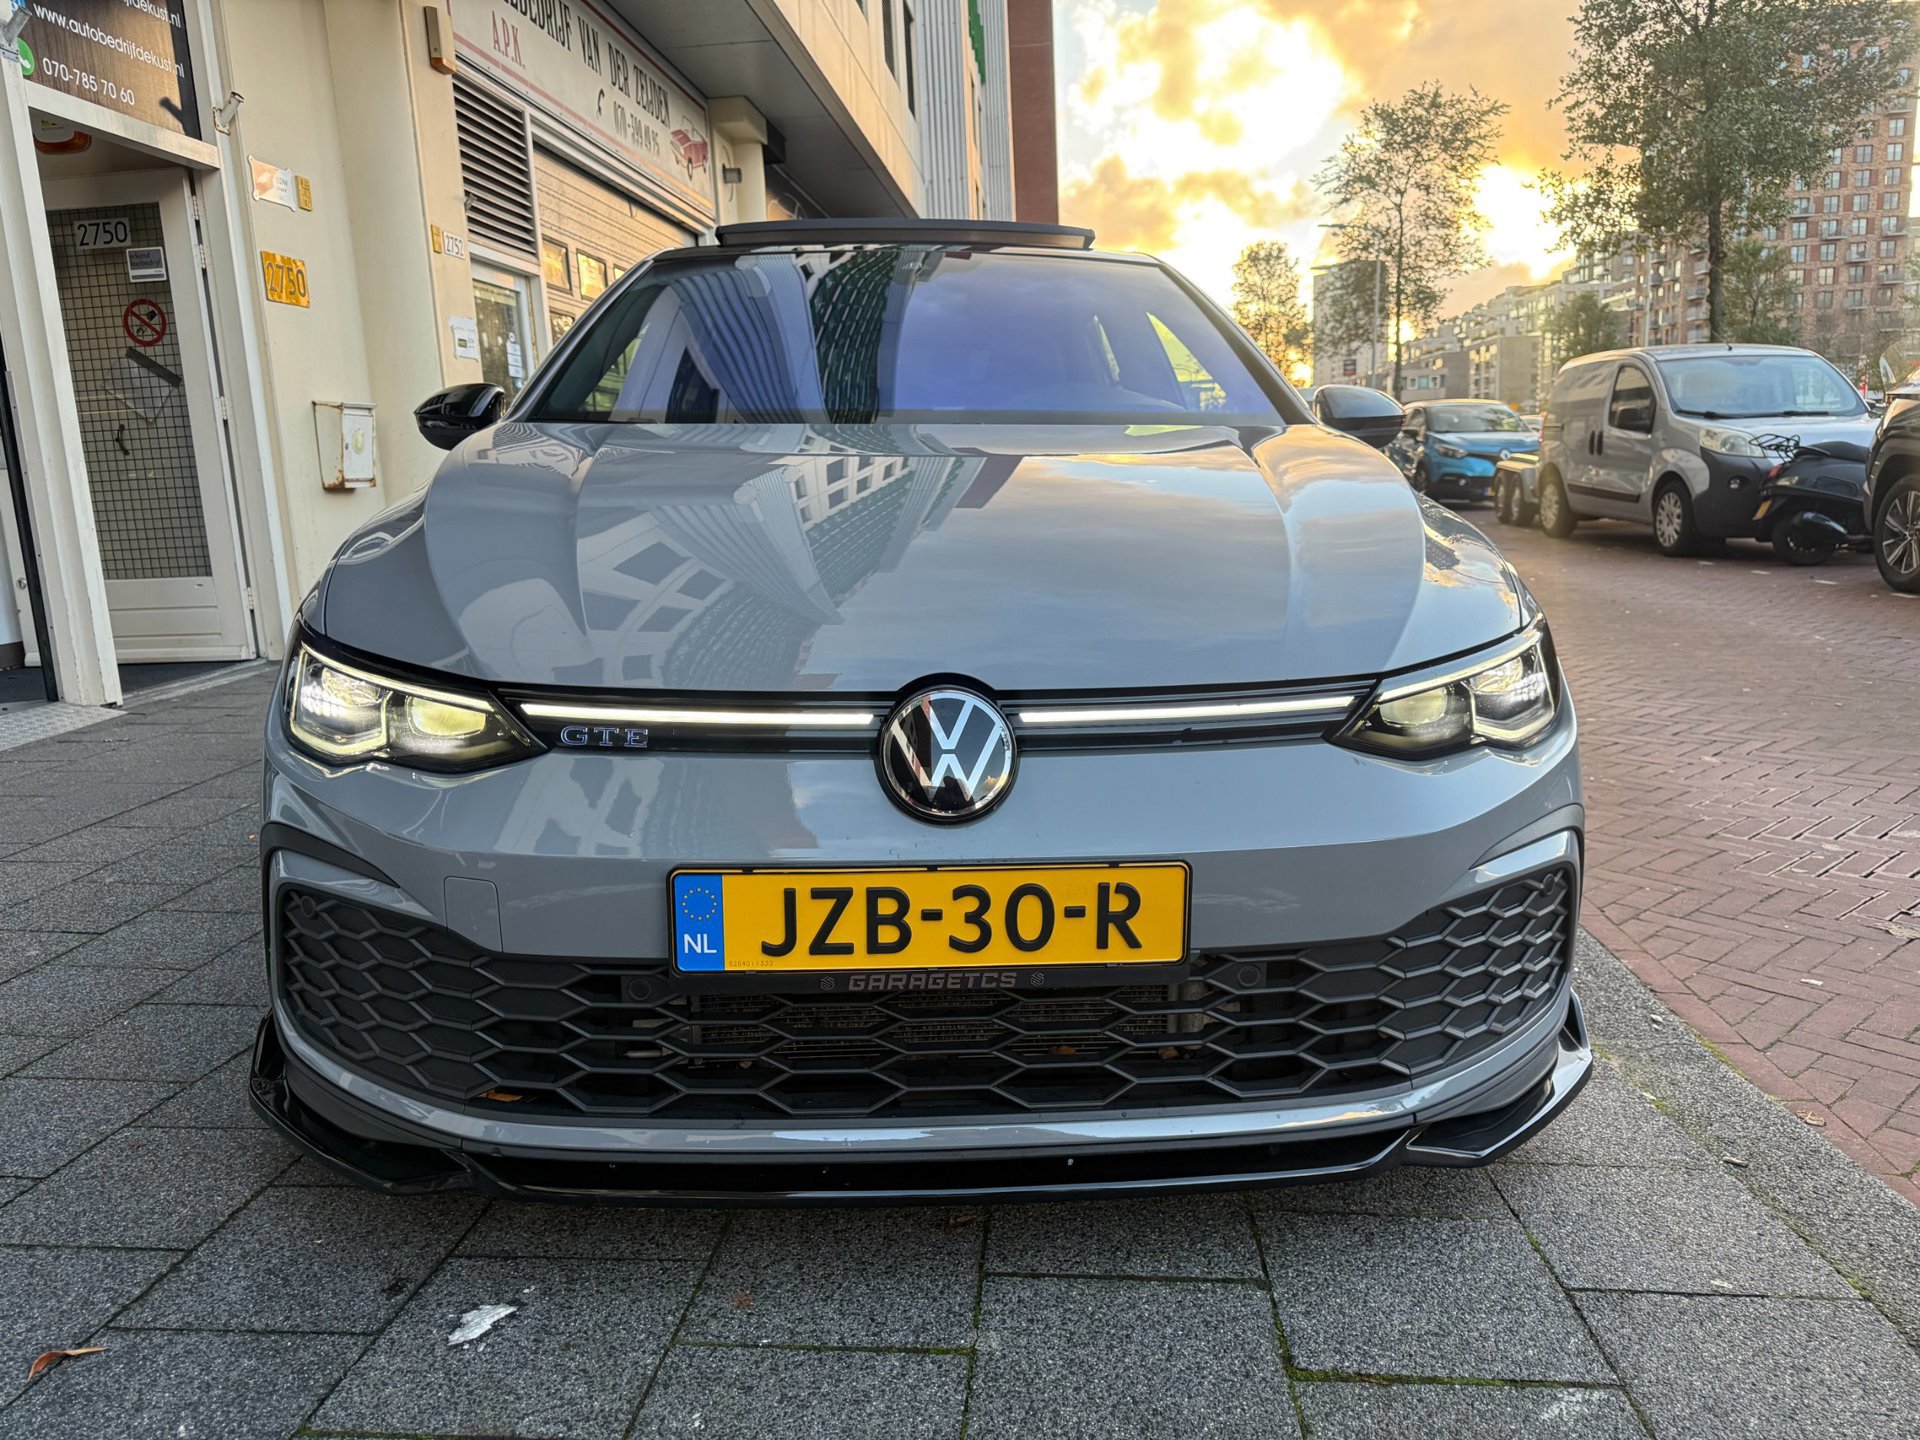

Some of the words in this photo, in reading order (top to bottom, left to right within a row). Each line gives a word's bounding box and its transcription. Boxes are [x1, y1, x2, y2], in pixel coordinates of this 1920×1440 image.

[33, 3, 185, 78] www.autobedrijfdekust.nl
[491, 10, 526, 69] A.P.K.
[577, 15, 602, 76] VAN
[607, 41, 631, 98] DER
[42, 57, 98, 92] 070-785
[100, 79, 117, 99] 70
[119, 87, 135, 106] 60
[77, 221, 128, 247] 2750
[266, 262, 307, 298] 2750
[560, 724, 649, 749] GTE
[760, 881, 1143, 958] JZB-30-R
[683, 934, 718, 954] NL
[848, 972, 1018, 992] GARAGETCS
